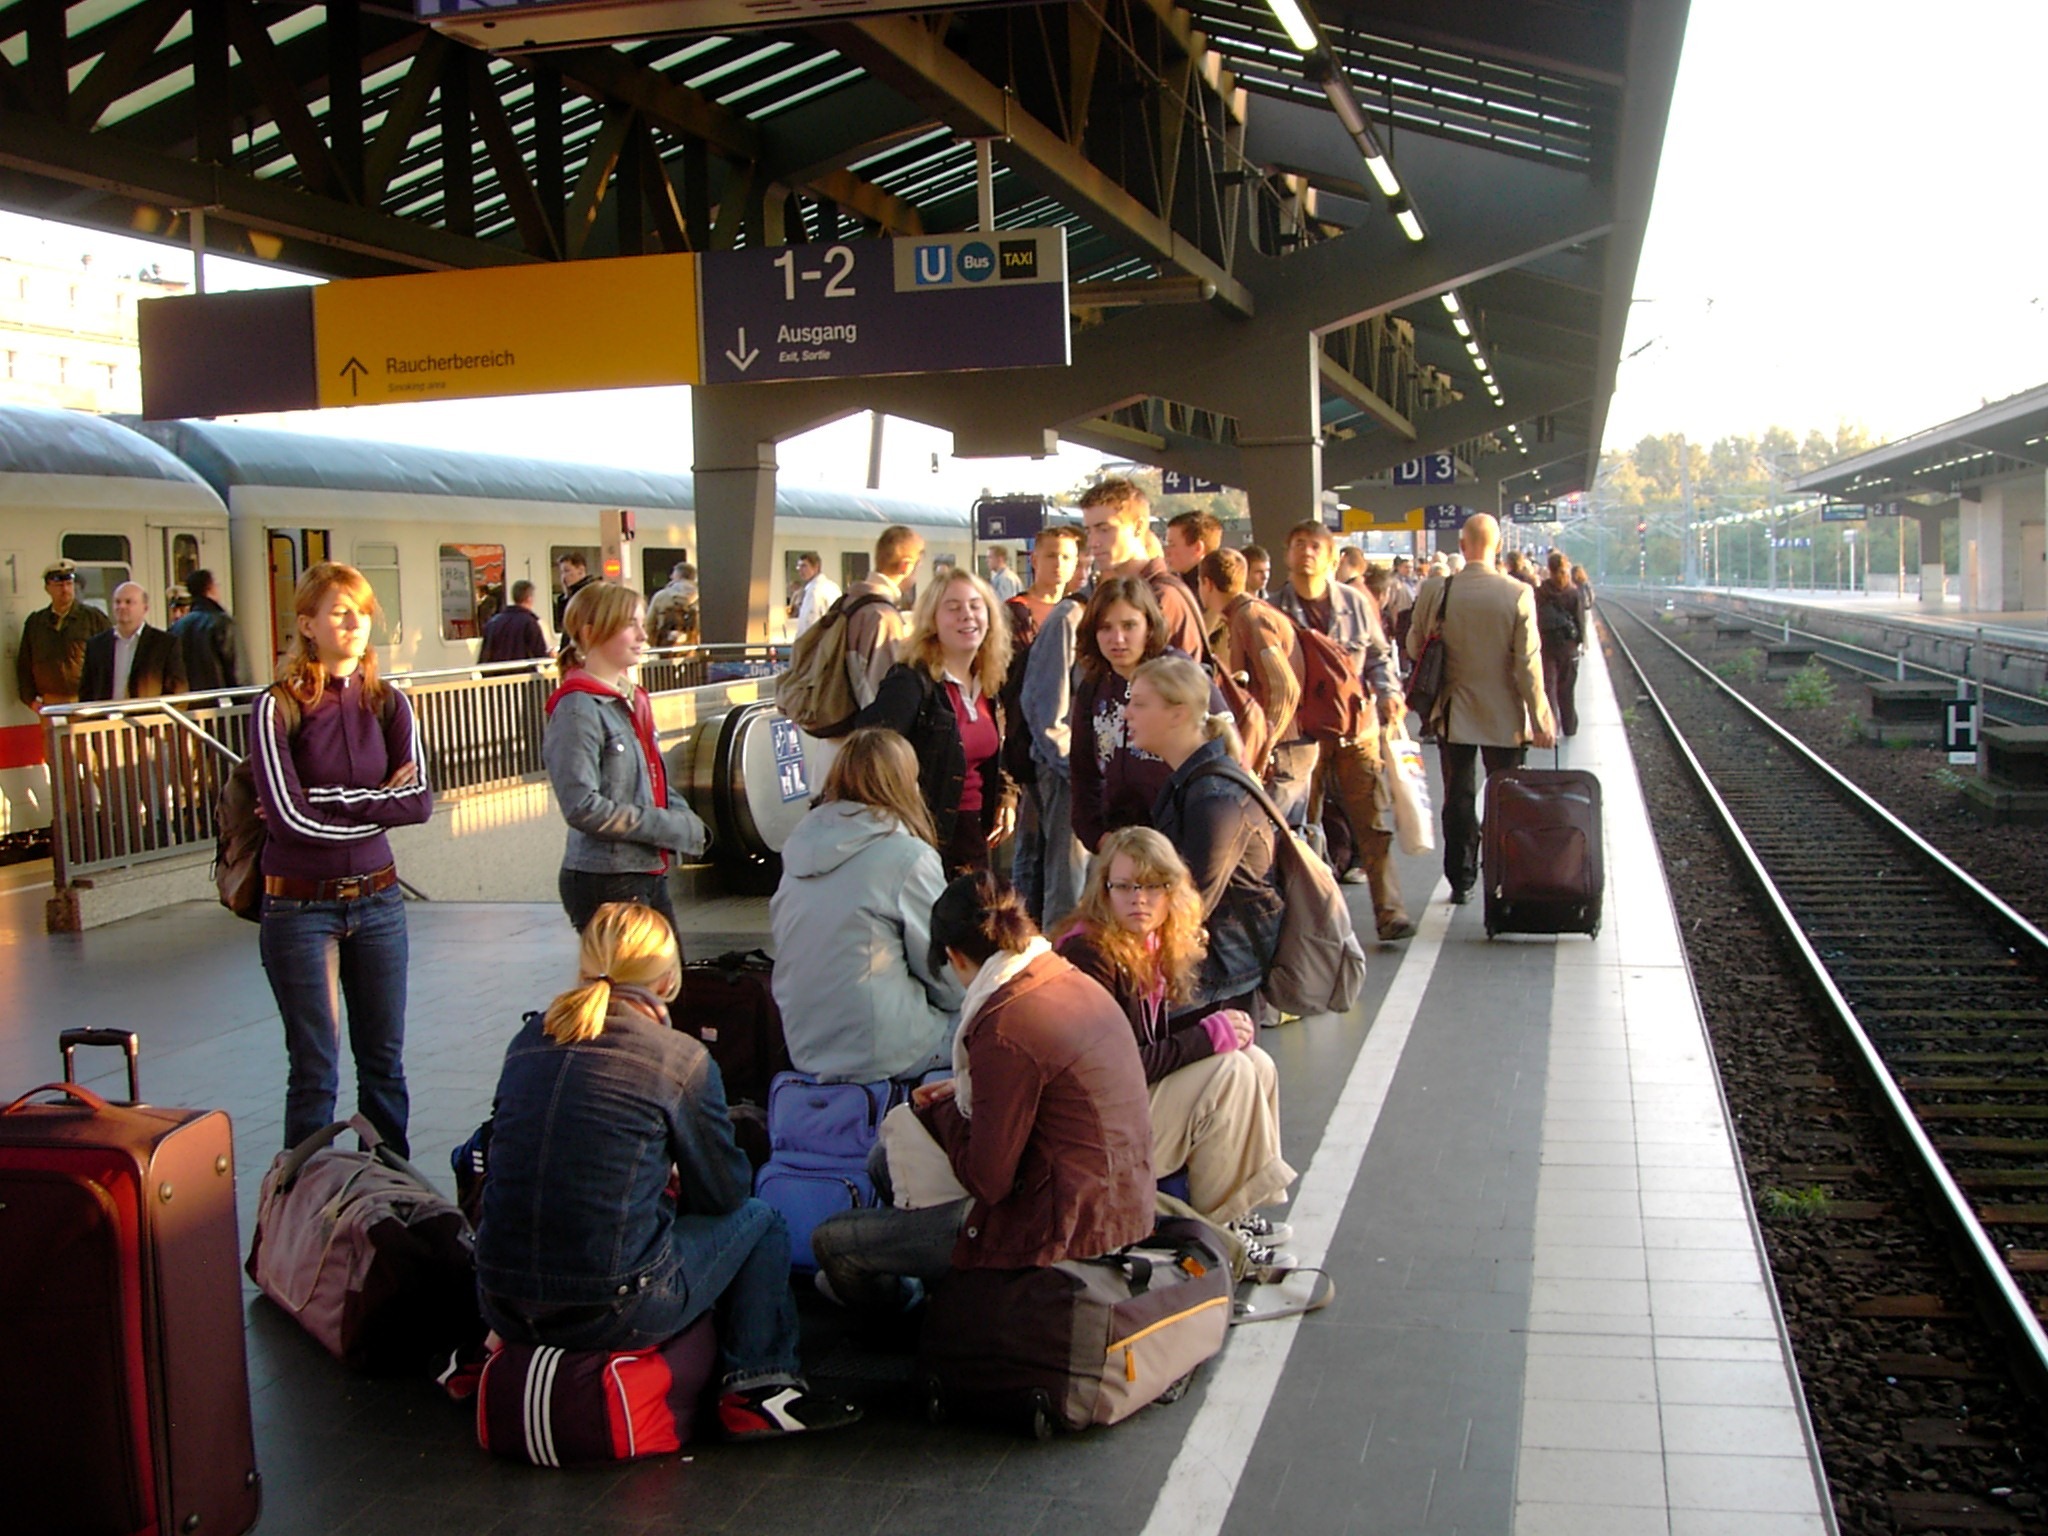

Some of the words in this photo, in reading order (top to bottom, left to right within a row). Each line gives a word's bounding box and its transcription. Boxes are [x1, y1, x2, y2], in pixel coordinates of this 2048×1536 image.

[921, 247, 946, 283] U
[963, 255, 990, 270] Bus
[1003, 251, 1034, 267] TAXI
[773, 245, 857, 300] 1-2
[777, 324, 857, 346] Ausgang
[386, 350, 515, 374] Raucherbereich
[779, 351, 800, 363] Exit,
[802, 350, 831, 361] Sortie
[1402, 458, 1419, 479] D
[1436, 455, 1451, 479] 3
[1165, 471, 1181, 487] 4
[1438, 505, 1456, 517] 1-2
[1528, 503, 1537, 514] 3
[1874, 503, 1883, 515] 2
[5, 553, 17, 594] 1
[1947, 705, 1977, 745] H
